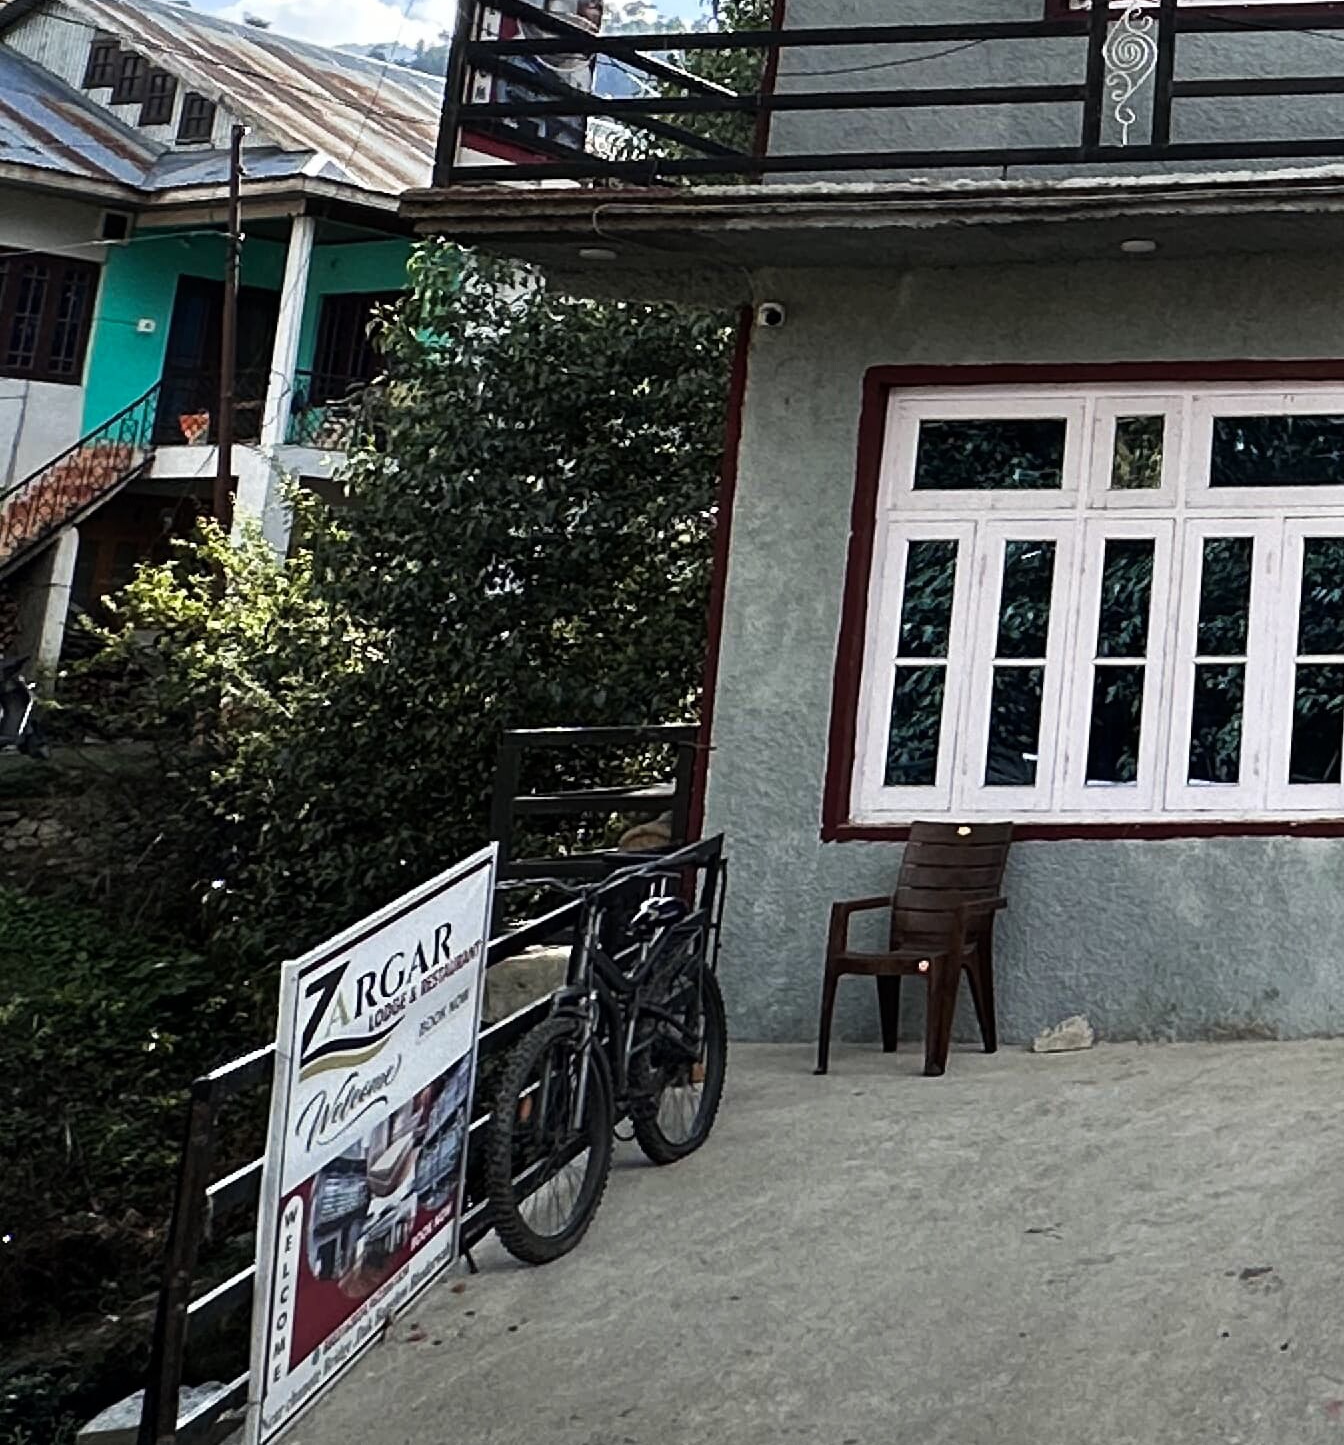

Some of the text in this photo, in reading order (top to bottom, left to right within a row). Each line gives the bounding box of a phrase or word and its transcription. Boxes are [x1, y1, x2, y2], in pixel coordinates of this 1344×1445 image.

[301, 922, 452, 1057] ZARGAR
[368, 991, 407, 1032] LODGE
[272, 1205, 299, 1384] WELCOME
